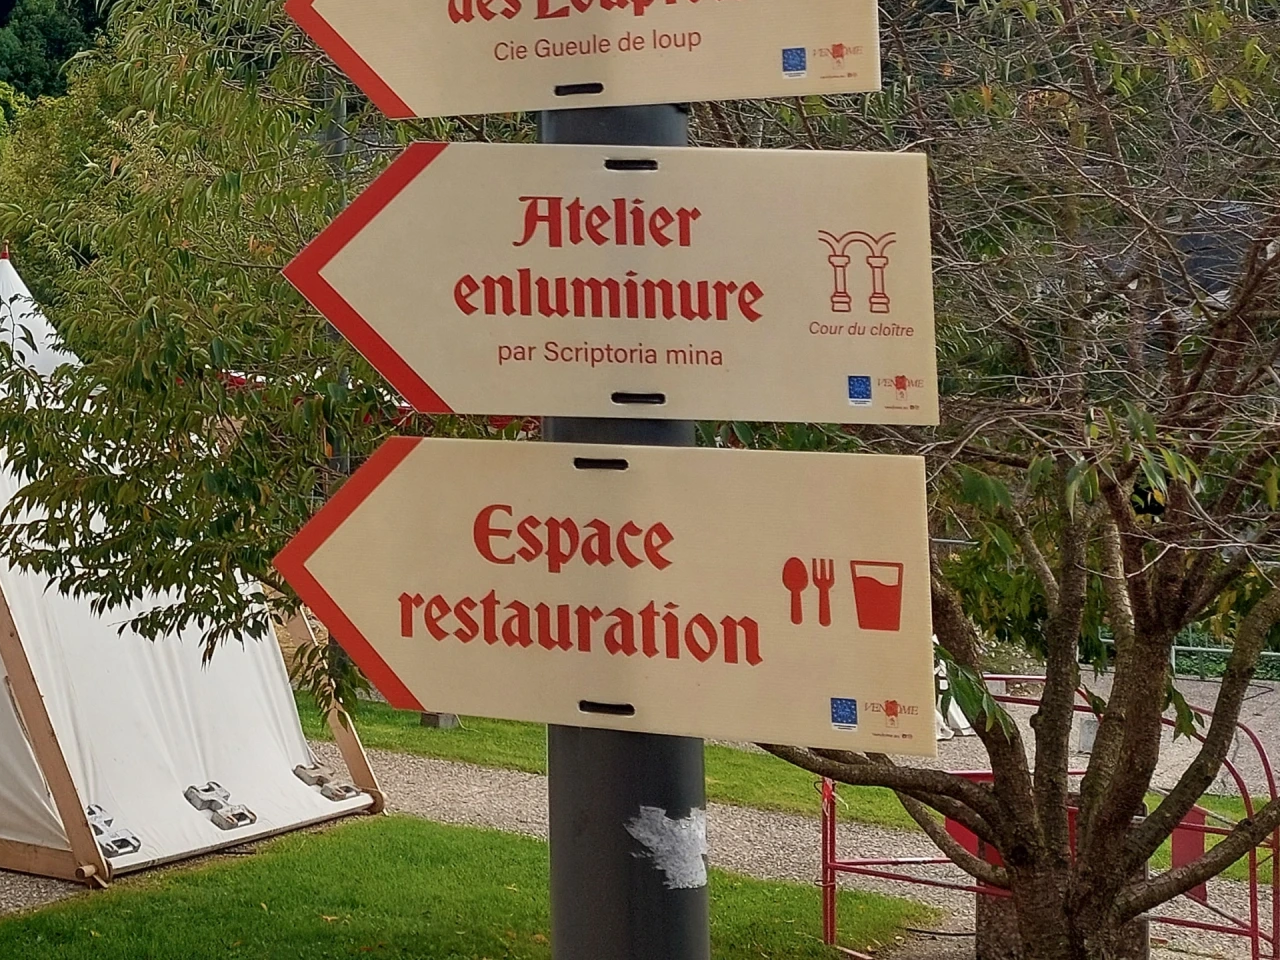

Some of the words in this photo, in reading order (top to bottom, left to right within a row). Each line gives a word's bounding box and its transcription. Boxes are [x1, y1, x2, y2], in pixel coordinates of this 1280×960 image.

[493, 40, 529, 61] Cie
[534, 33, 611, 59] Gueule
[617, 31, 646, 52] de
[652, 28, 702, 53] loup
[511, 195, 703, 248] Atelier
[453, 267, 765, 323] enluminure
[497, 344, 537, 366] par
[543, 340, 658, 369] Scriptoria
[665, 343, 723, 366] mina
[808, 321, 845, 335] Cour
[847, 321, 867, 336] du
[869, 322, 915, 337] cloître
[472, 503, 675, 574] Espace
[397, 588, 764, 667] restauration
